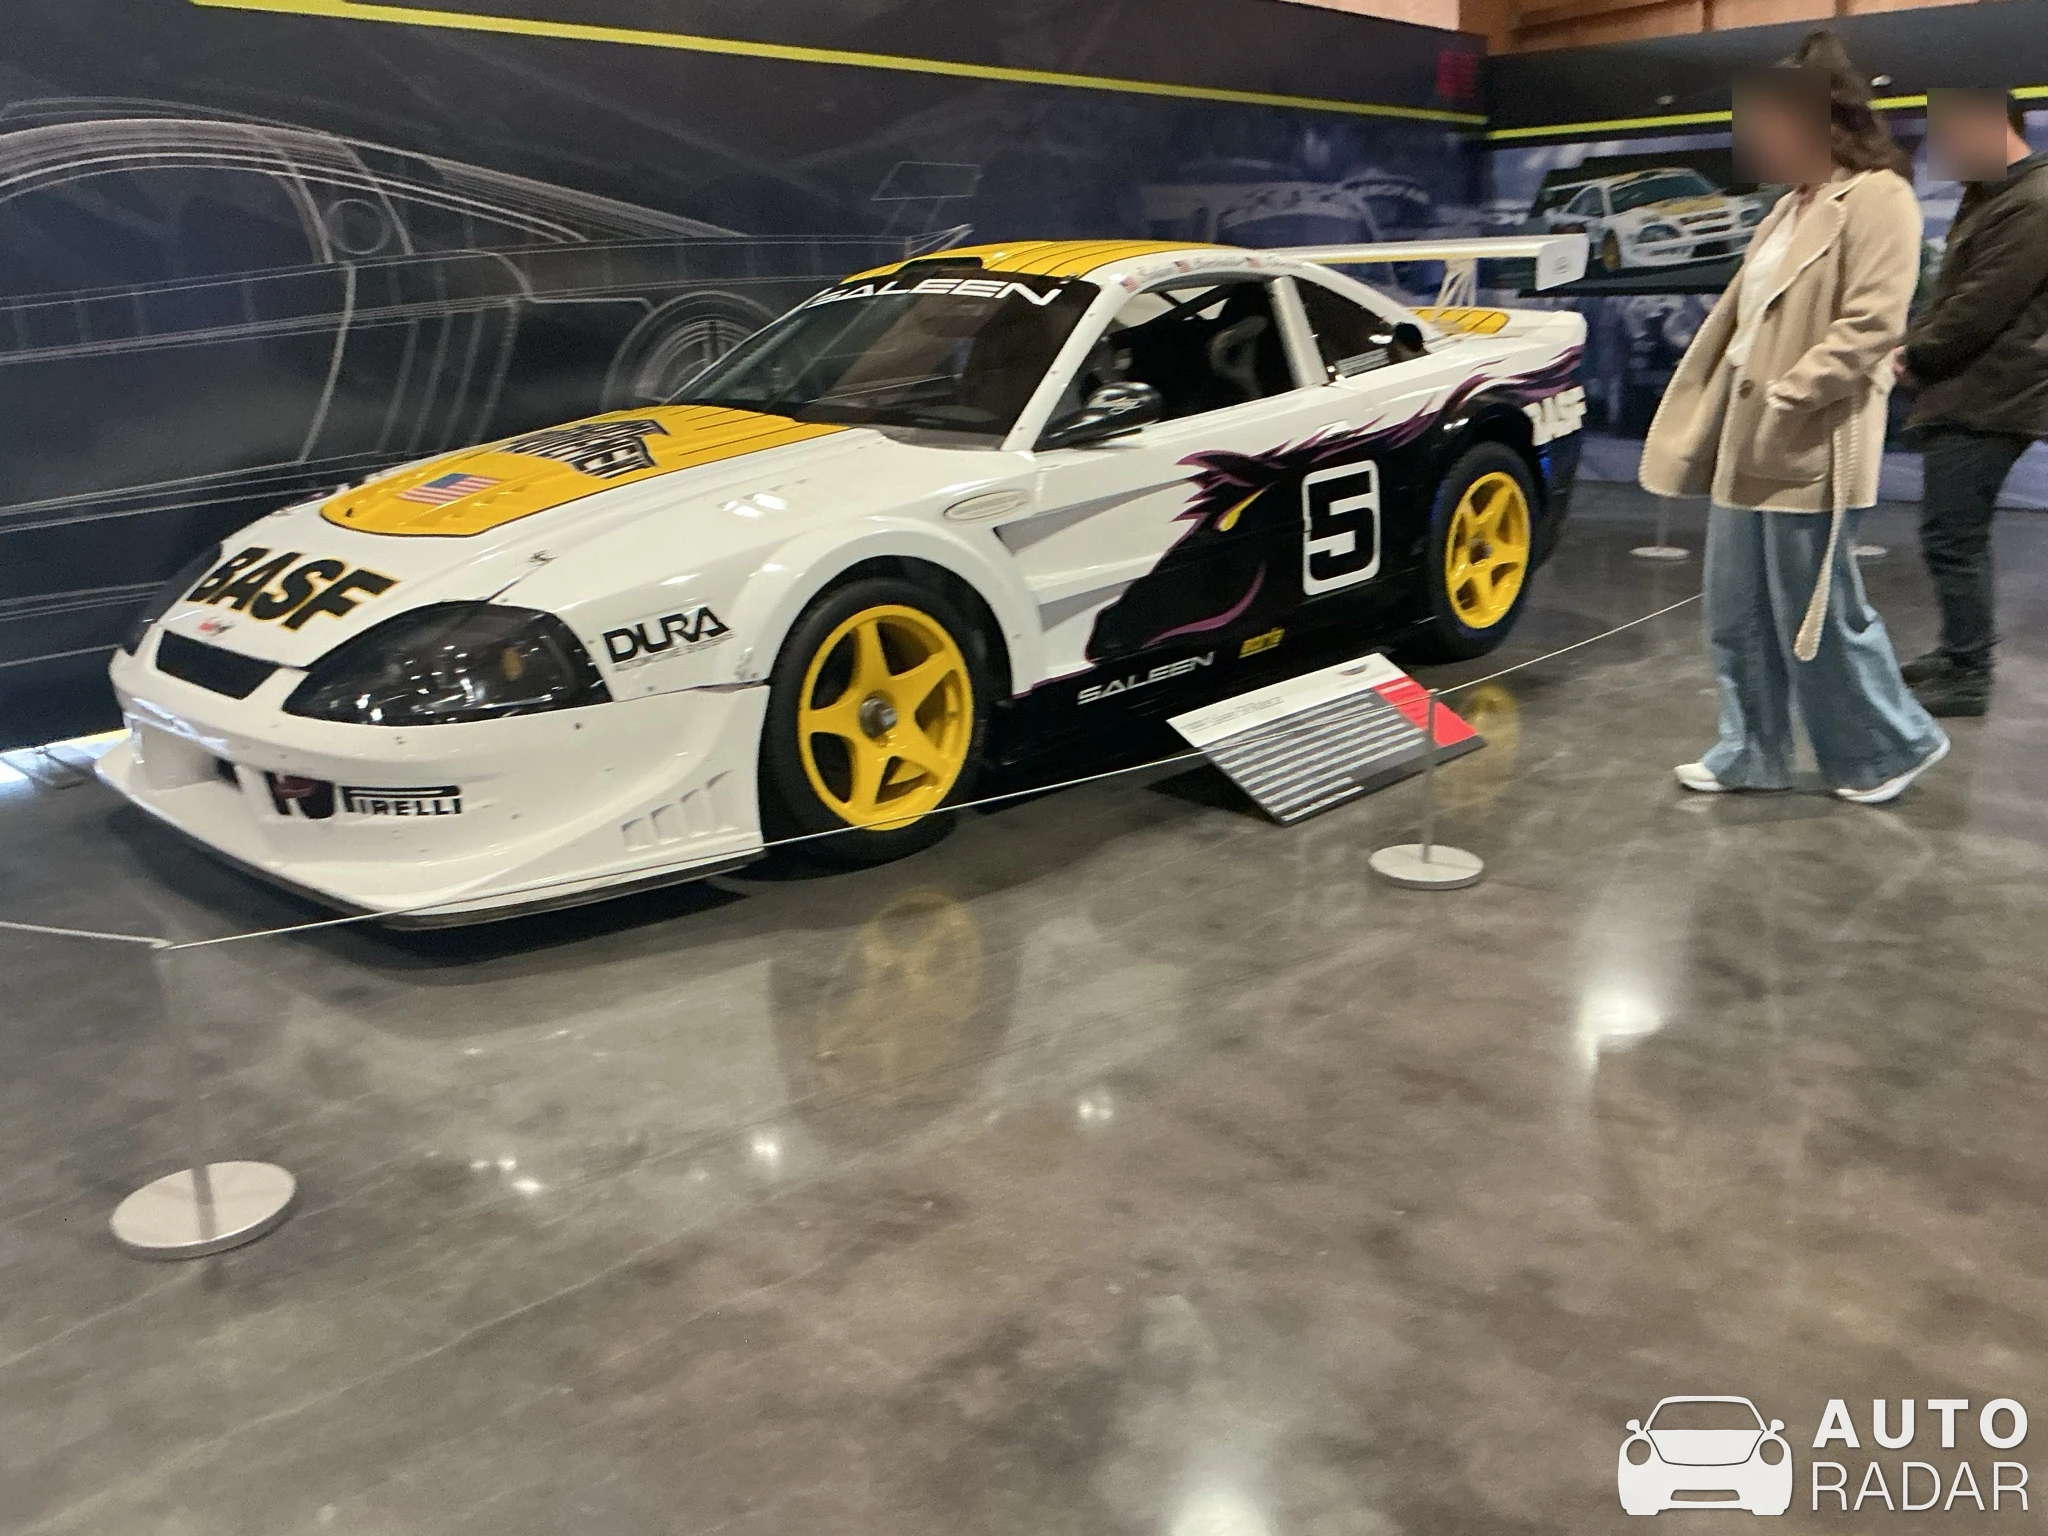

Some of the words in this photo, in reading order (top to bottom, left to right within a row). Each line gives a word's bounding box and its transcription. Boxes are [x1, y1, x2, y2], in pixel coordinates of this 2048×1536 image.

[805, 278, 1063, 309] SALEEN
[1305, 465, 1378, 588] 5
[186, 547, 399, 631] BASF
[603, 606, 730, 663] DURA
[1077, 651, 1215, 706] SALEEN
[341, 785, 462, 816] PIRELLI
